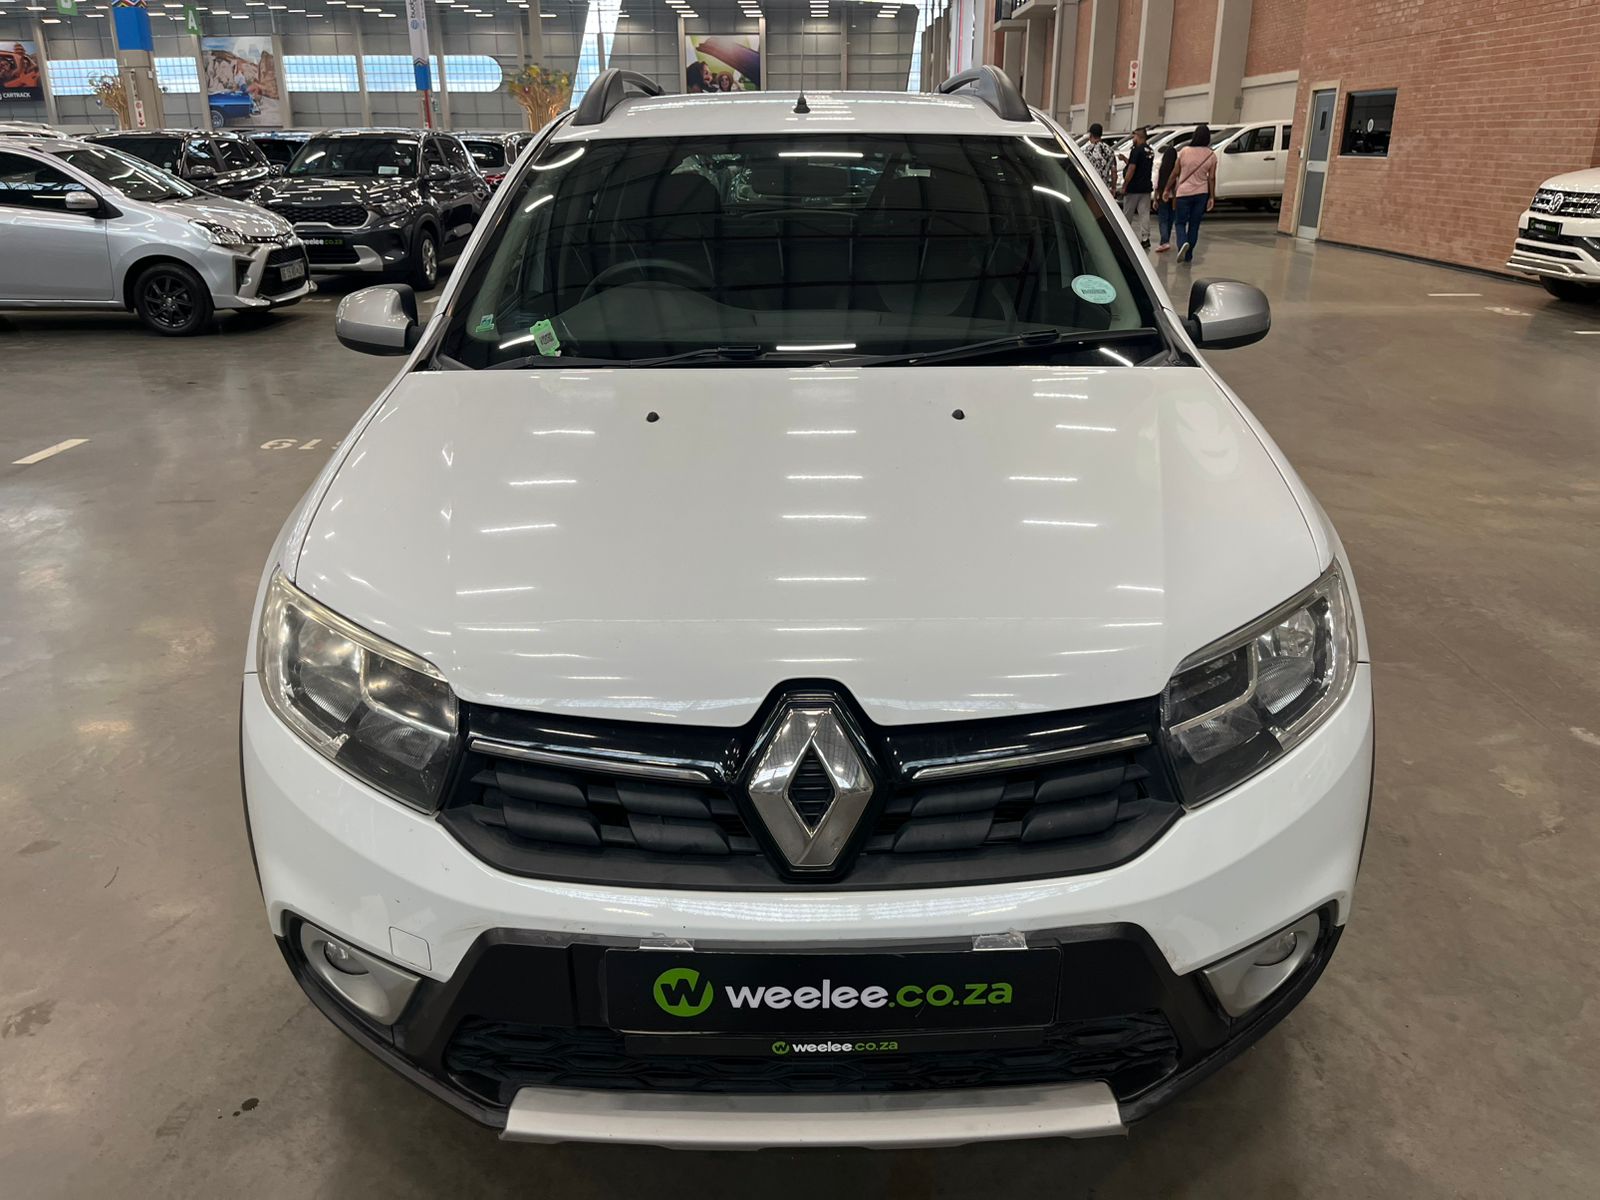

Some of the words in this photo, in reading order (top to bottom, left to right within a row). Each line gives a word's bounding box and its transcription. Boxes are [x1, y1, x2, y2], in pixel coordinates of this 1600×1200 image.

[188, 11, 197, 30] A
[725, 979, 1013, 1009] weelee.co.za
[792, 1041, 898, 1053] weelee.co.za
